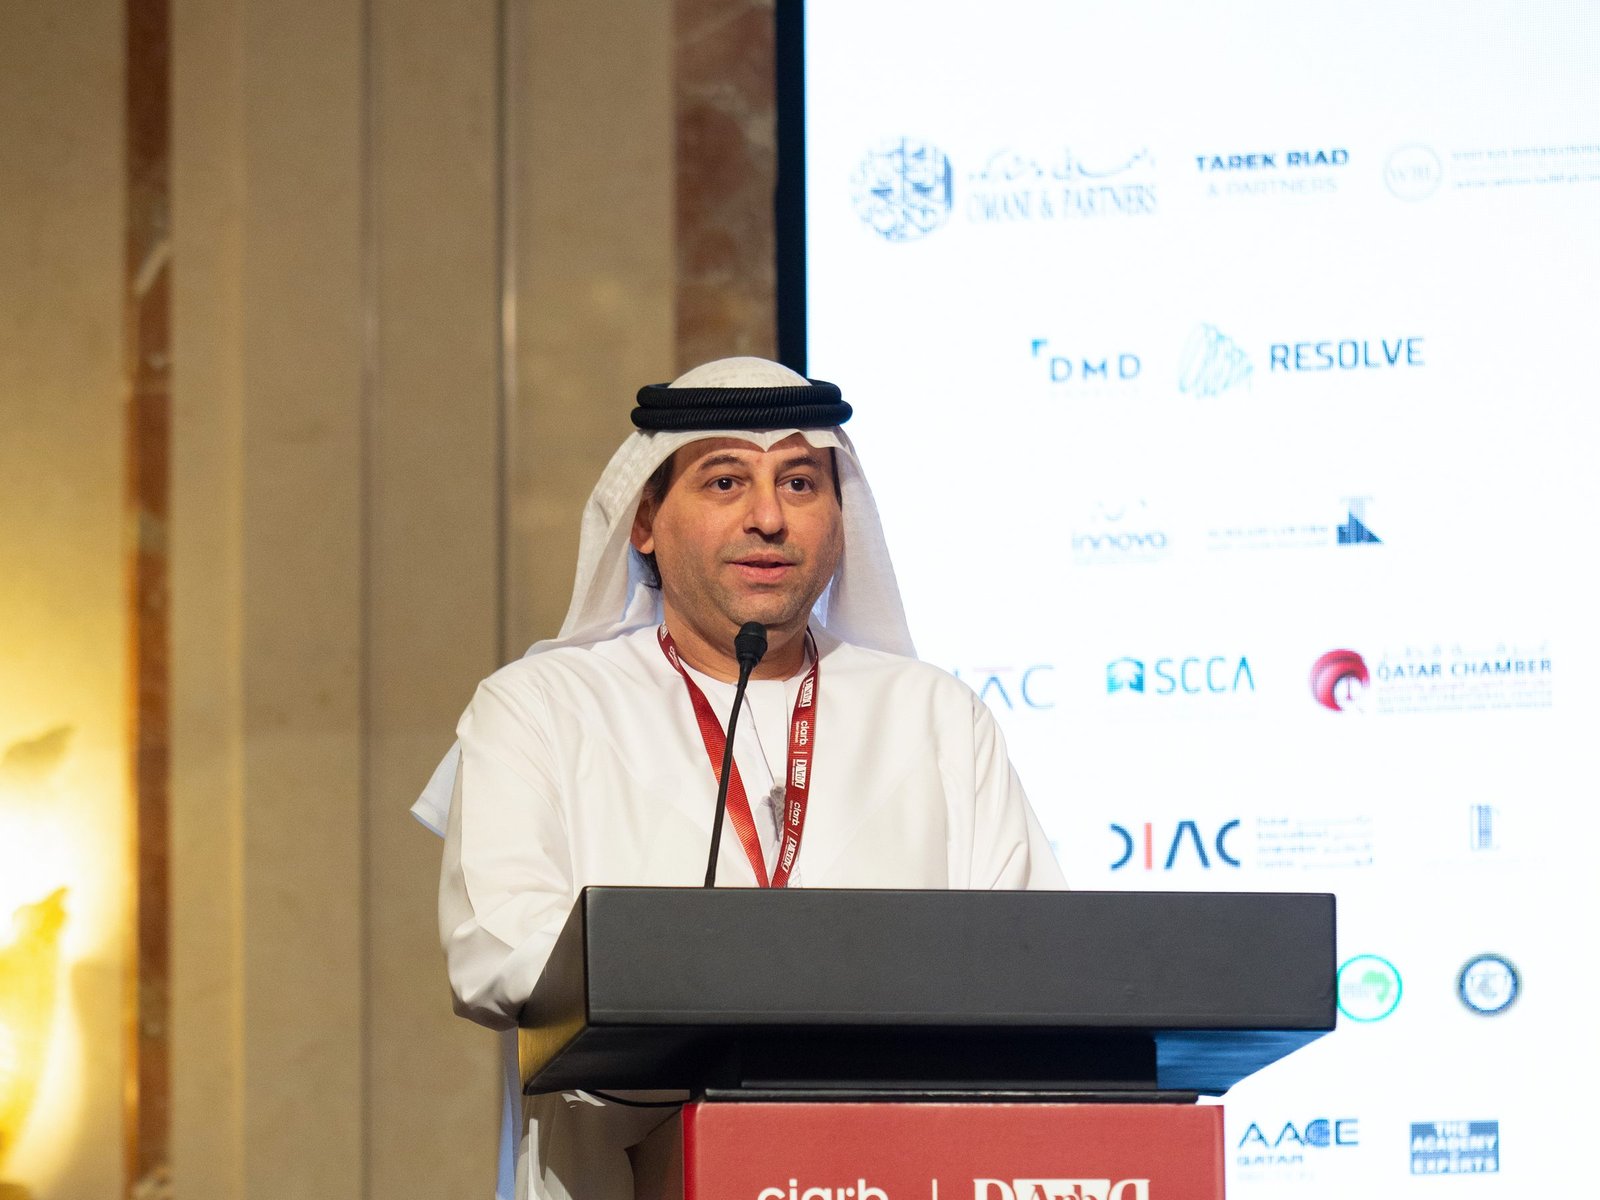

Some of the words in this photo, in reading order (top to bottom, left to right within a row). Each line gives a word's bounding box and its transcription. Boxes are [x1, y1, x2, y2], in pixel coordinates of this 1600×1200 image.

[1195, 152, 1277, 173] TAREK
[1287, 148, 1350, 168] RIAD
[1050, 354, 1142, 384] DMD
[1269, 337, 1426, 373] RESOLVE
[1155, 656, 1256, 695] SCCA
[1377, 663, 1441, 681] QATAR
[1450, 657, 1551, 676] CHAMBER
